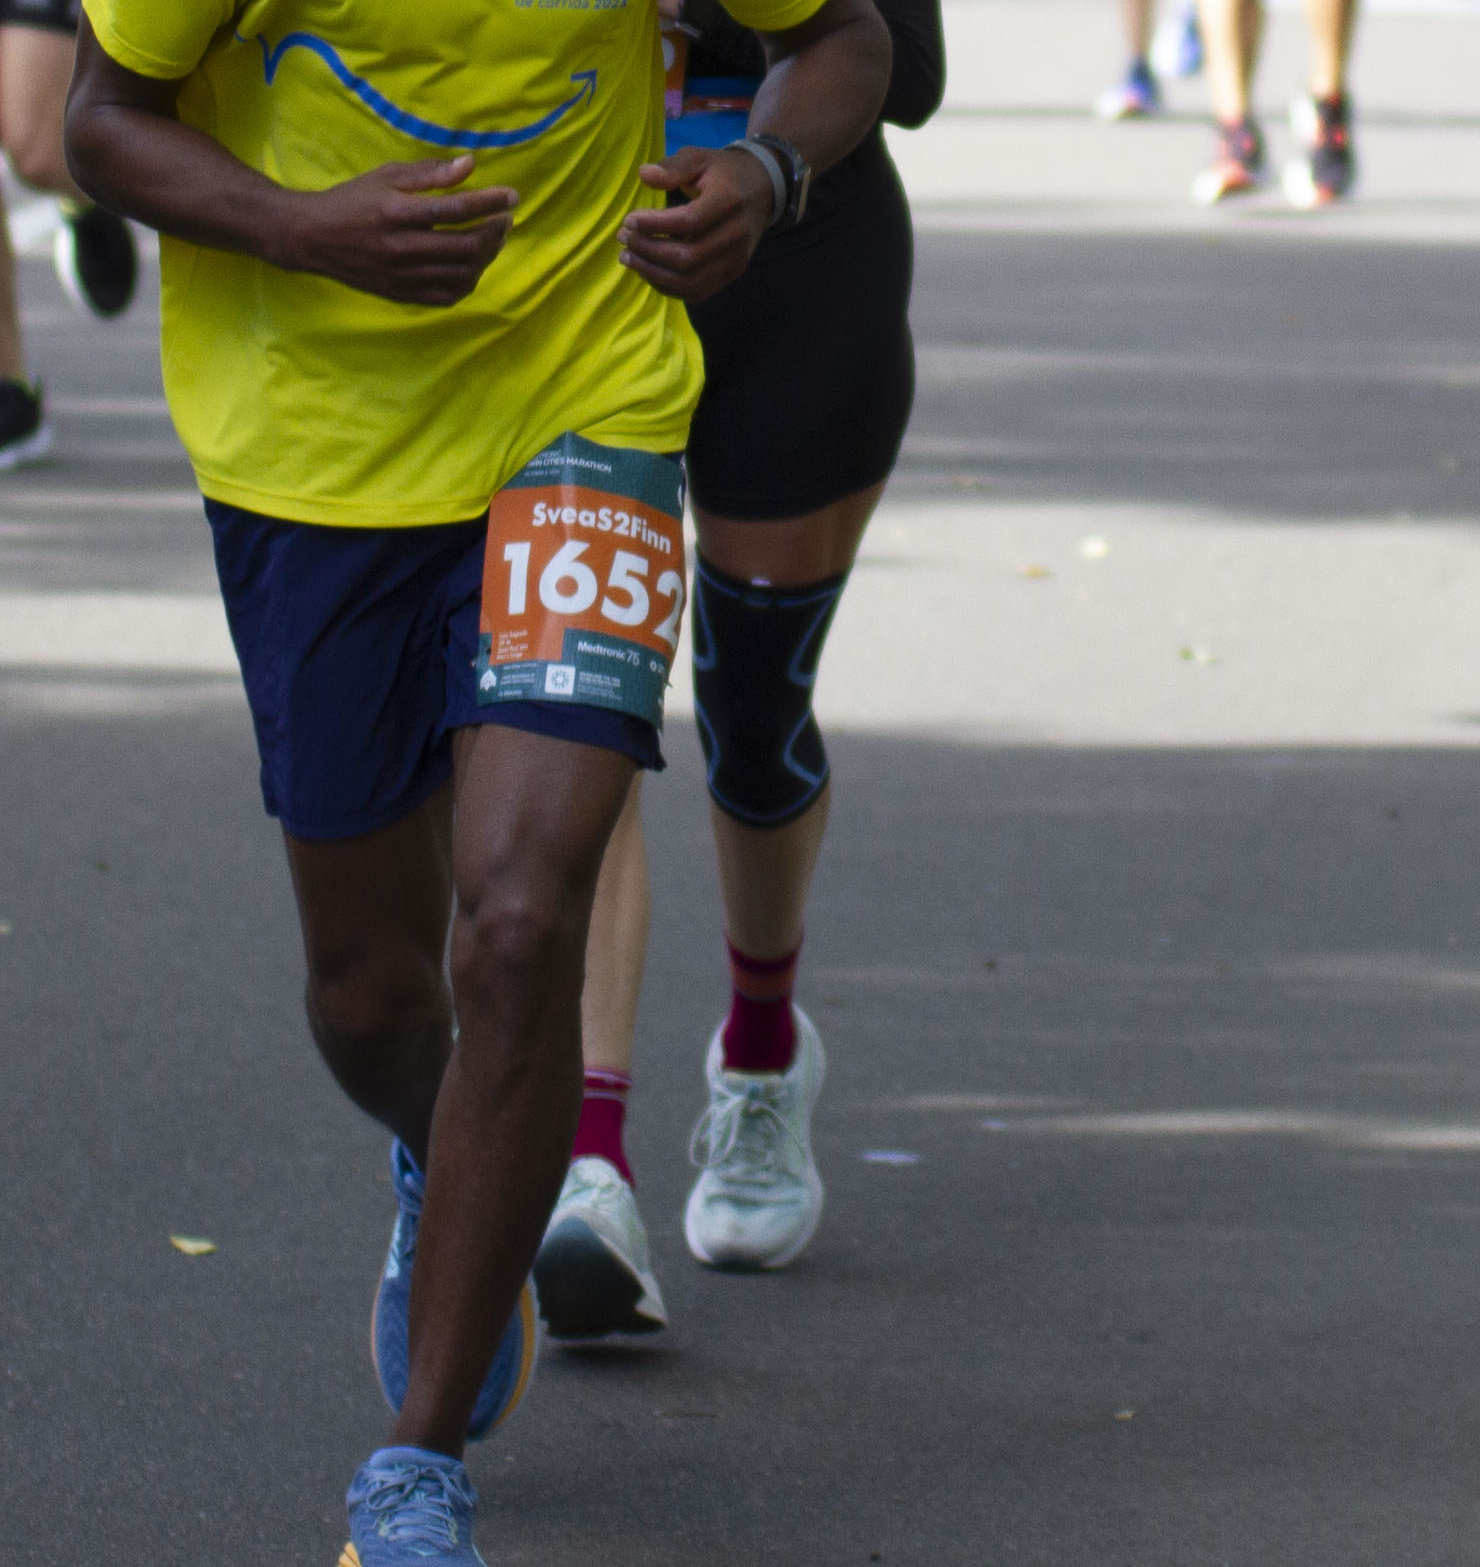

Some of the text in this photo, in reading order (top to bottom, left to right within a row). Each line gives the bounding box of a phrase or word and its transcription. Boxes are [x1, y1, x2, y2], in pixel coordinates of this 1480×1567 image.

[566, 456, 612, 473] MARATHON
[531, 502, 672, 555] SveaS2Finn
[503, 539, 685, 651] 1652
[577, 640, 626, 660] Medtronic
